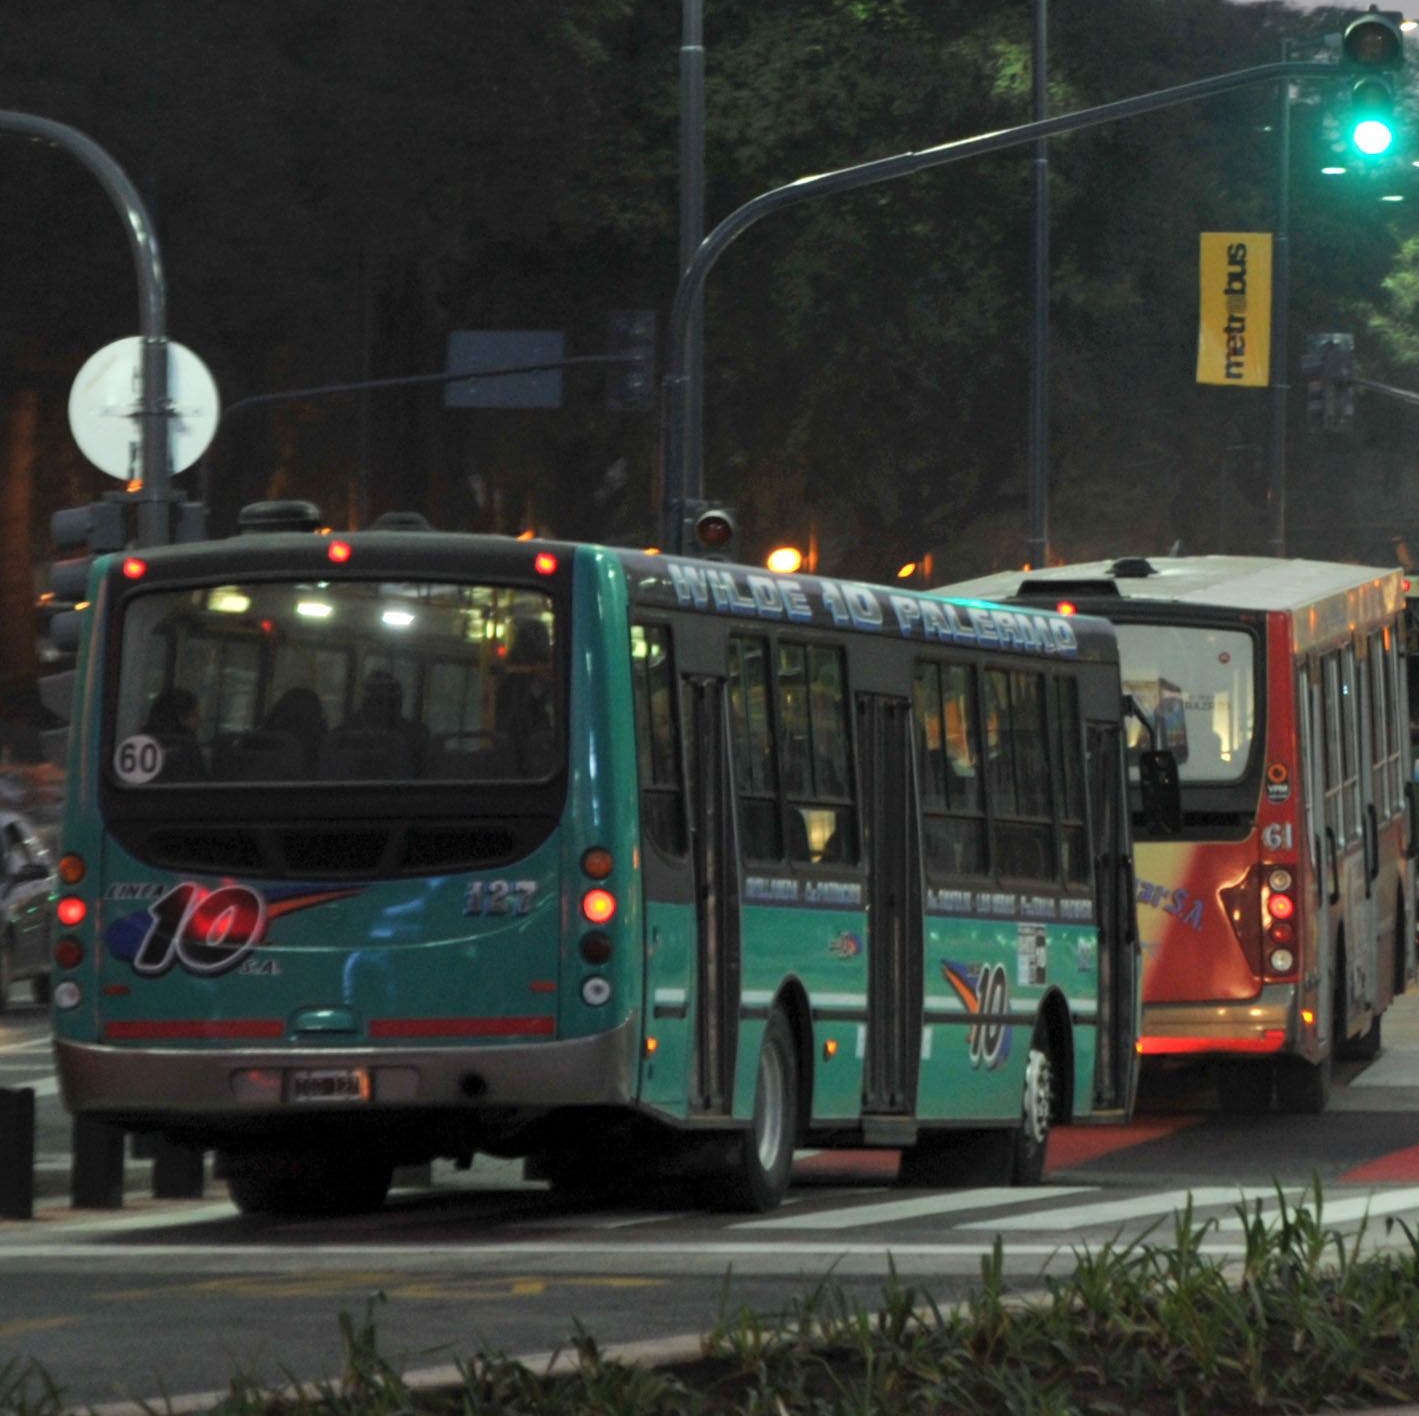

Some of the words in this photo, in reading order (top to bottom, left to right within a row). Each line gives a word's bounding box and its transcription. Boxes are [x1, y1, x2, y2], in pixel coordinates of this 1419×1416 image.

[667, 563, 813, 621] WILDE
[820, 581, 883, 630] 10
[889, 594, 1078, 660] PALERMO
[119, 743, 158, 774] 60
[1262, 823, 1293, 851] 61
[134, 882, 266, 975] 10
[462, 879, 537, 916] 127
[968, 962, 1011, 1066] 10
